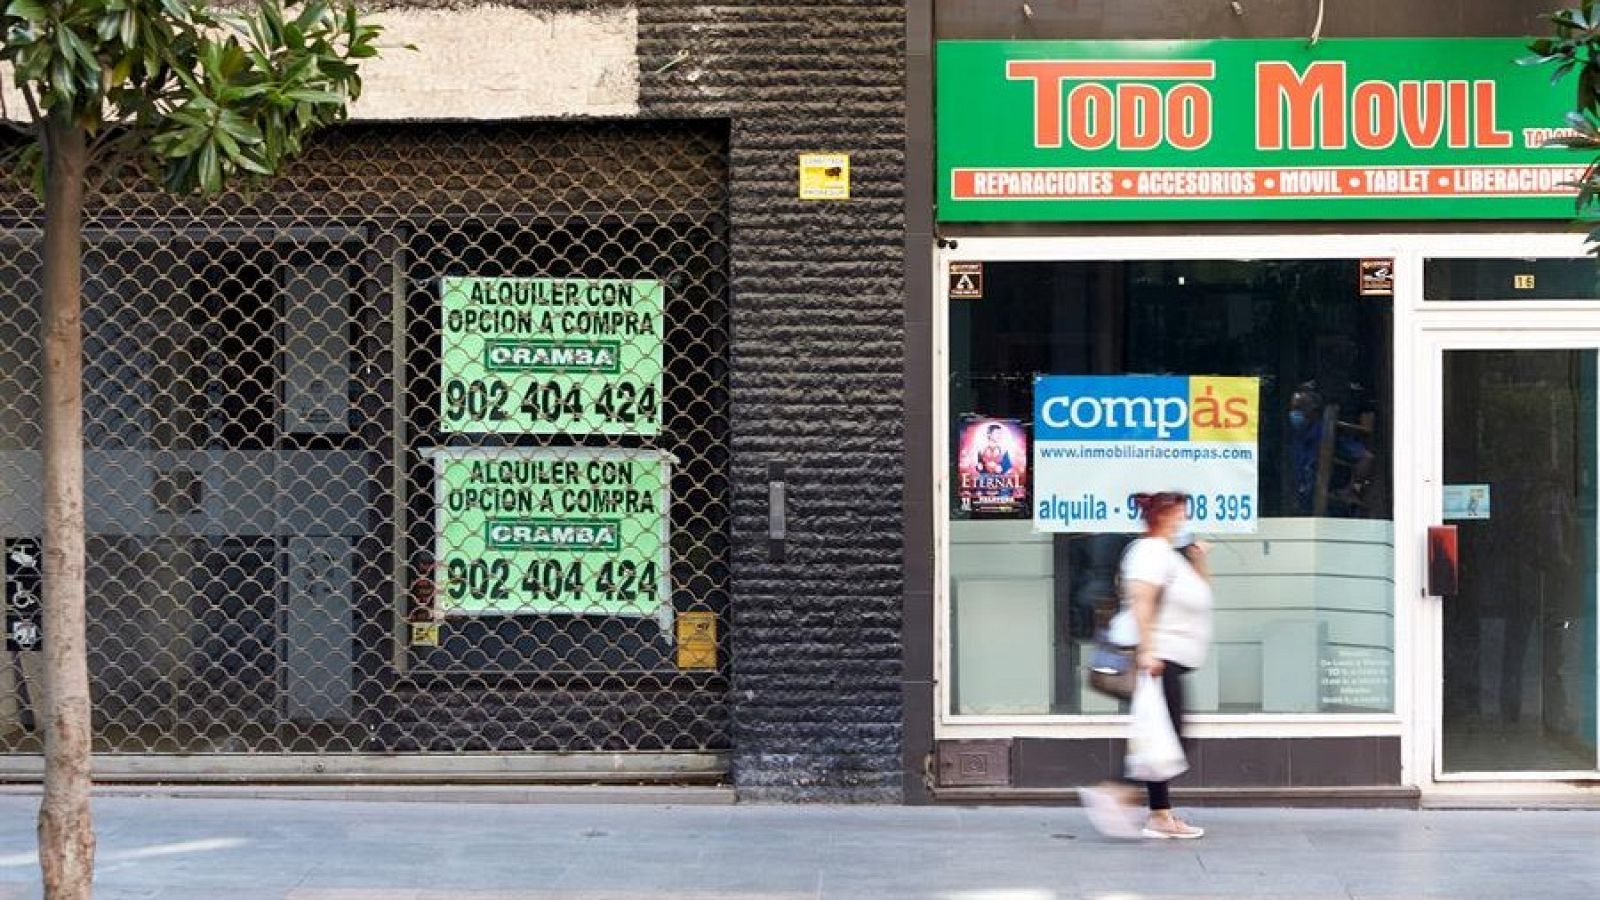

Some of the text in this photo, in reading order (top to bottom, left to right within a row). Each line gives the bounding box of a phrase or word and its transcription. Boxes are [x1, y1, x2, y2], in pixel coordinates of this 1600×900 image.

[974, 171, 1114, 194] REPARACIONES
[1137, 170, 1256, 194] ACCESORIOS
[1279, 170, 1343, 193] MOVIL
[1363, 169, 1430, 192] TABLET
[470, 282, 632, 307] ALQUILER CON
[447, 309, 655, 336] OPCION A COMPRA
[446, 379, 657, 423] 902 404 424
[1039, 444, 1253, 461] www.inmobiliariacompas.com
[470, 460, 633, 485] ALQUILER CON
[447, 488, 655, 514] OPCION A COMPRA
[1039, 493, 1107, 527] alquila
[1215, 493, 1251, 521] 395
[447, 557, 657, 602] 902 404 424
